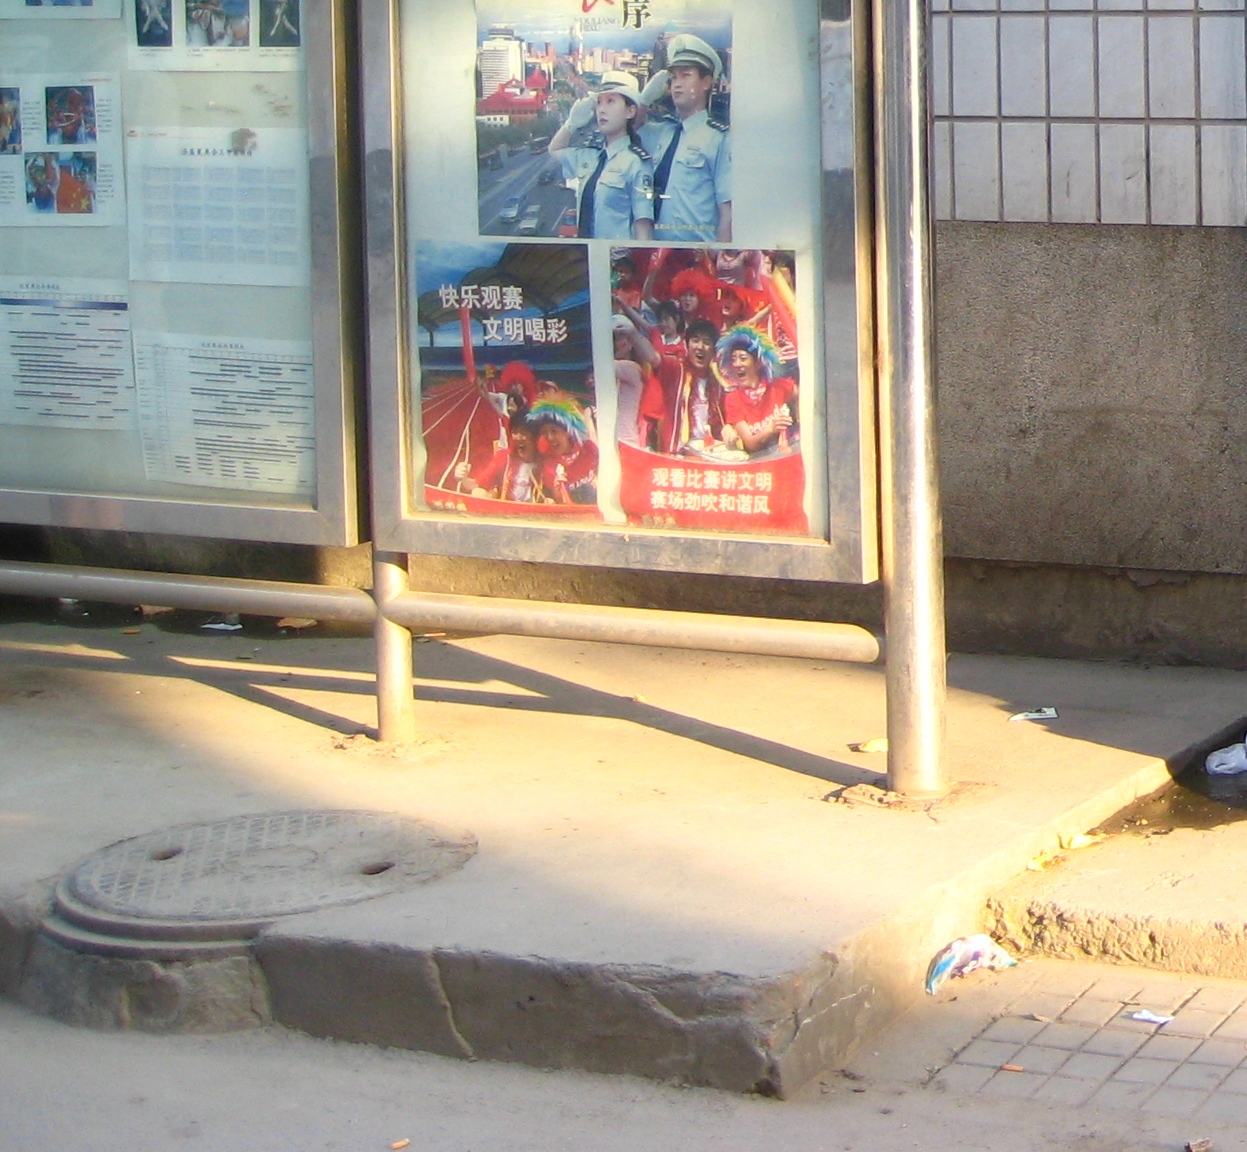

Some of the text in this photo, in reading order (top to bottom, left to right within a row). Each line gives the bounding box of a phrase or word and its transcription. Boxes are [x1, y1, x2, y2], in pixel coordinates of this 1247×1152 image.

[438, 284, 524, 311] 快乐观赛
[482, 316, 568, 344] 文明喝彩
[651, 467, 773, 492] 观看比赛讲文明
[650, 490, 771, 515] 赛场劲吹和谐风
